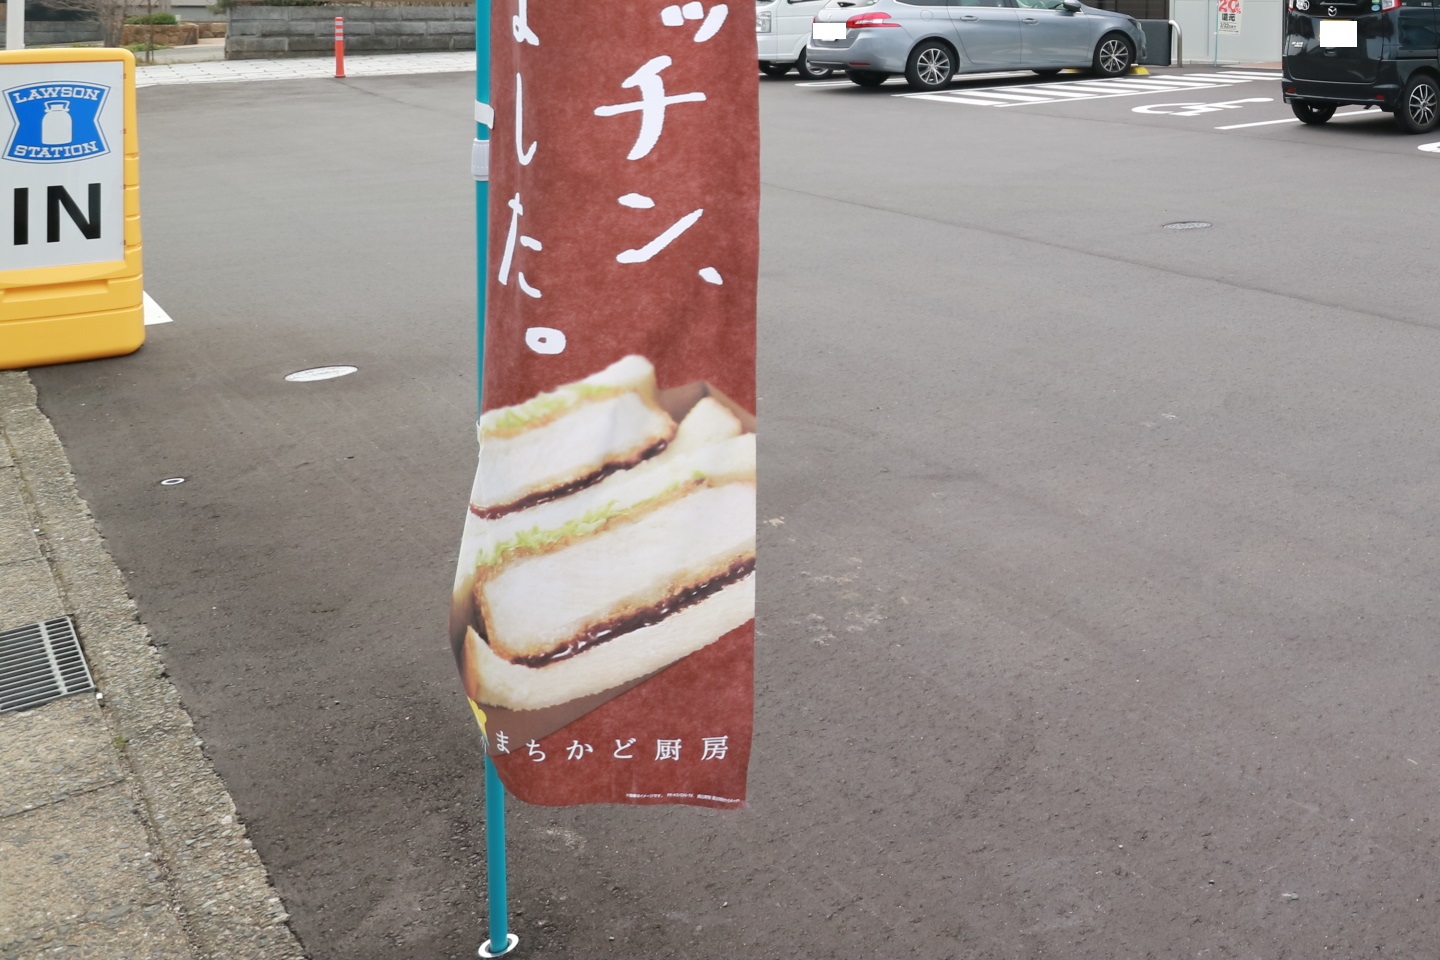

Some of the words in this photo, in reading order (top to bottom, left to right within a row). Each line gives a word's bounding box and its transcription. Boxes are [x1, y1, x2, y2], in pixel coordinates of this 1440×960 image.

[14, 86, 101, 104] LAWSON
[14, 141, 99, 159] STATION
[13, 182, 102, 246] IN
[495, 730, 730, 763] まちかど厨房
